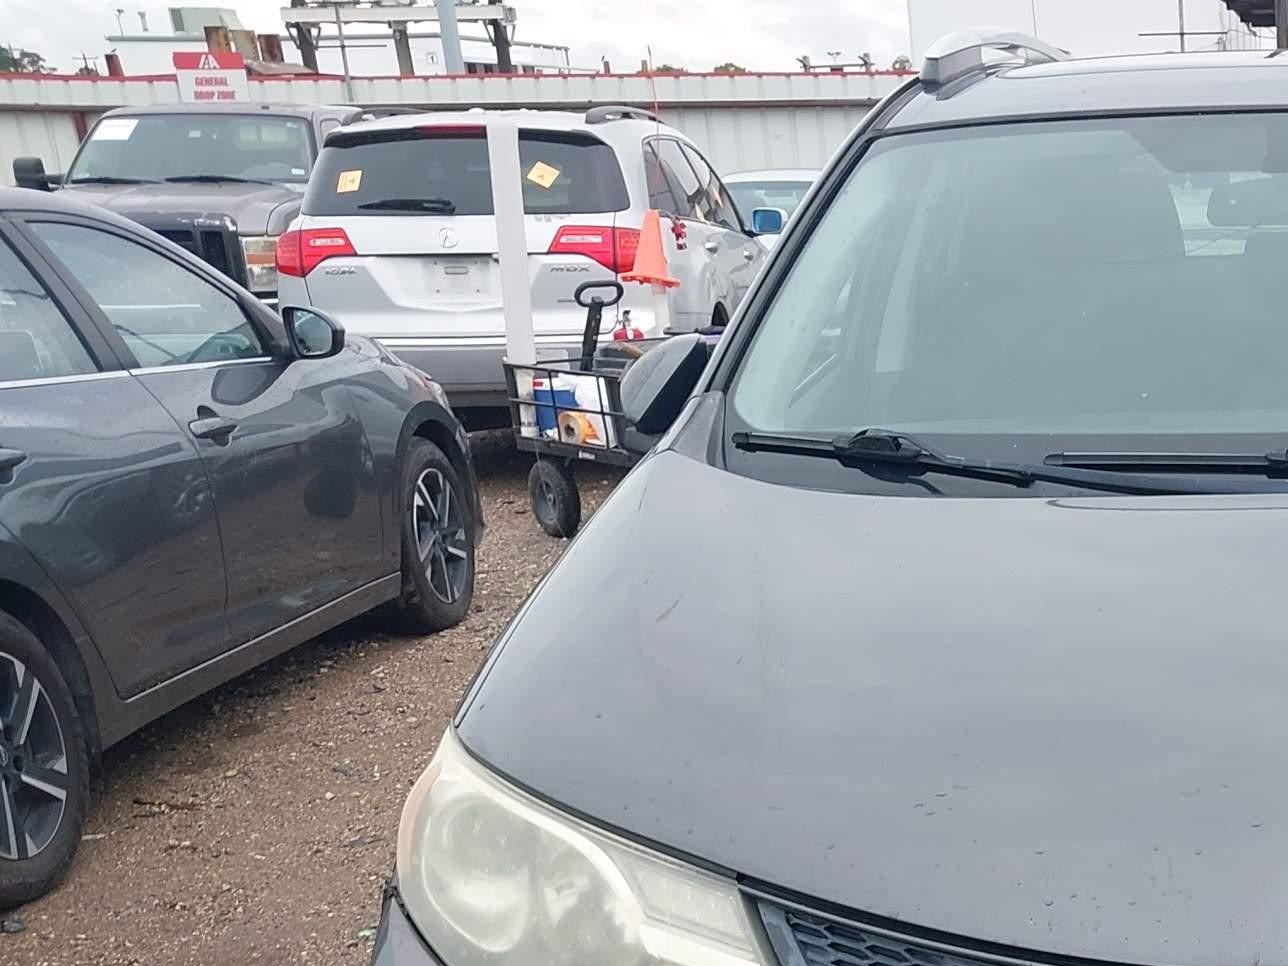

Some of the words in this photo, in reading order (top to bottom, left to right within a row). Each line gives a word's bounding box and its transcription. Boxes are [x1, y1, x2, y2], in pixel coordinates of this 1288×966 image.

[194, 77, 229, 87] GENERAL
[193, 90, 216, 100] DROP
[216, 90, 236, 100] ZONE
